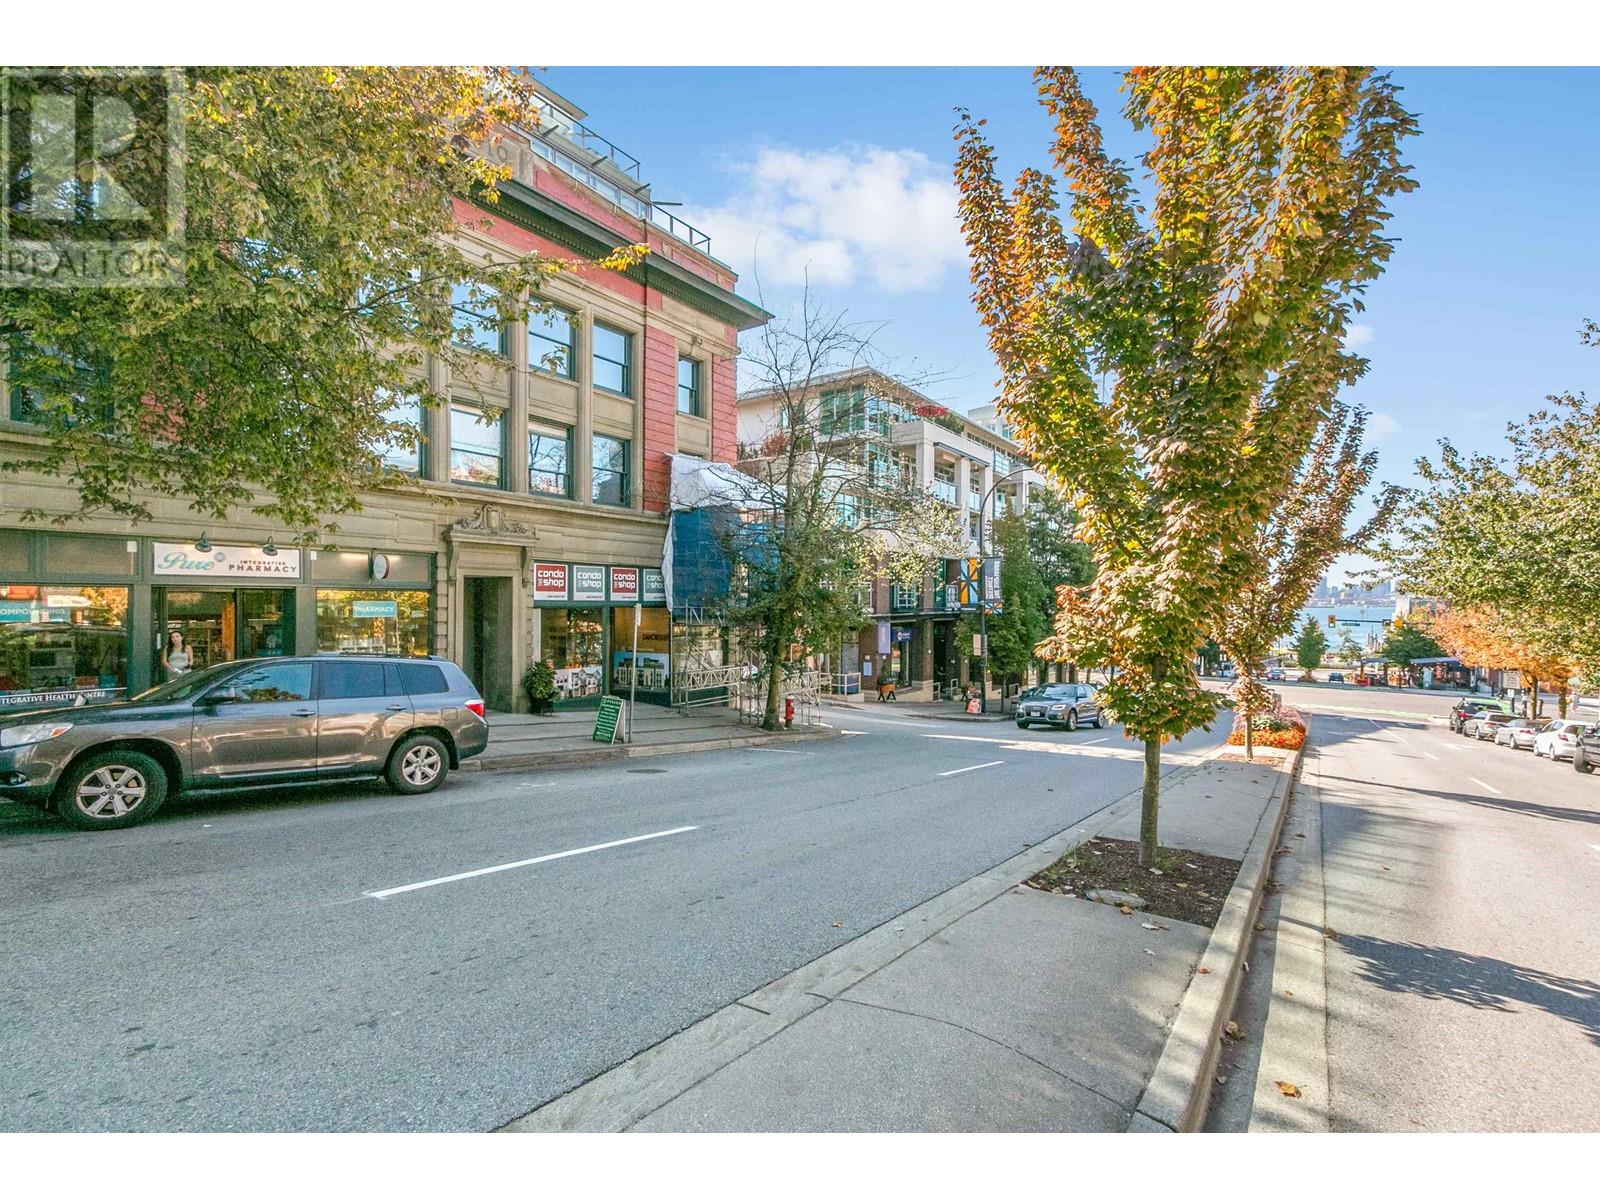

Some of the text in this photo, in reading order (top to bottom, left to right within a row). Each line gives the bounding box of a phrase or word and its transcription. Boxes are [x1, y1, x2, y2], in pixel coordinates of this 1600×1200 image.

[158, 552, 215, 571] Pure
[229, 564, 297, 574] PHARMACY
[578, 571, 601, 579] condo
[543, 578, 564, 588] shop
[584, 579, 601, 588] shop
[619, 580, 635, 589] shop
